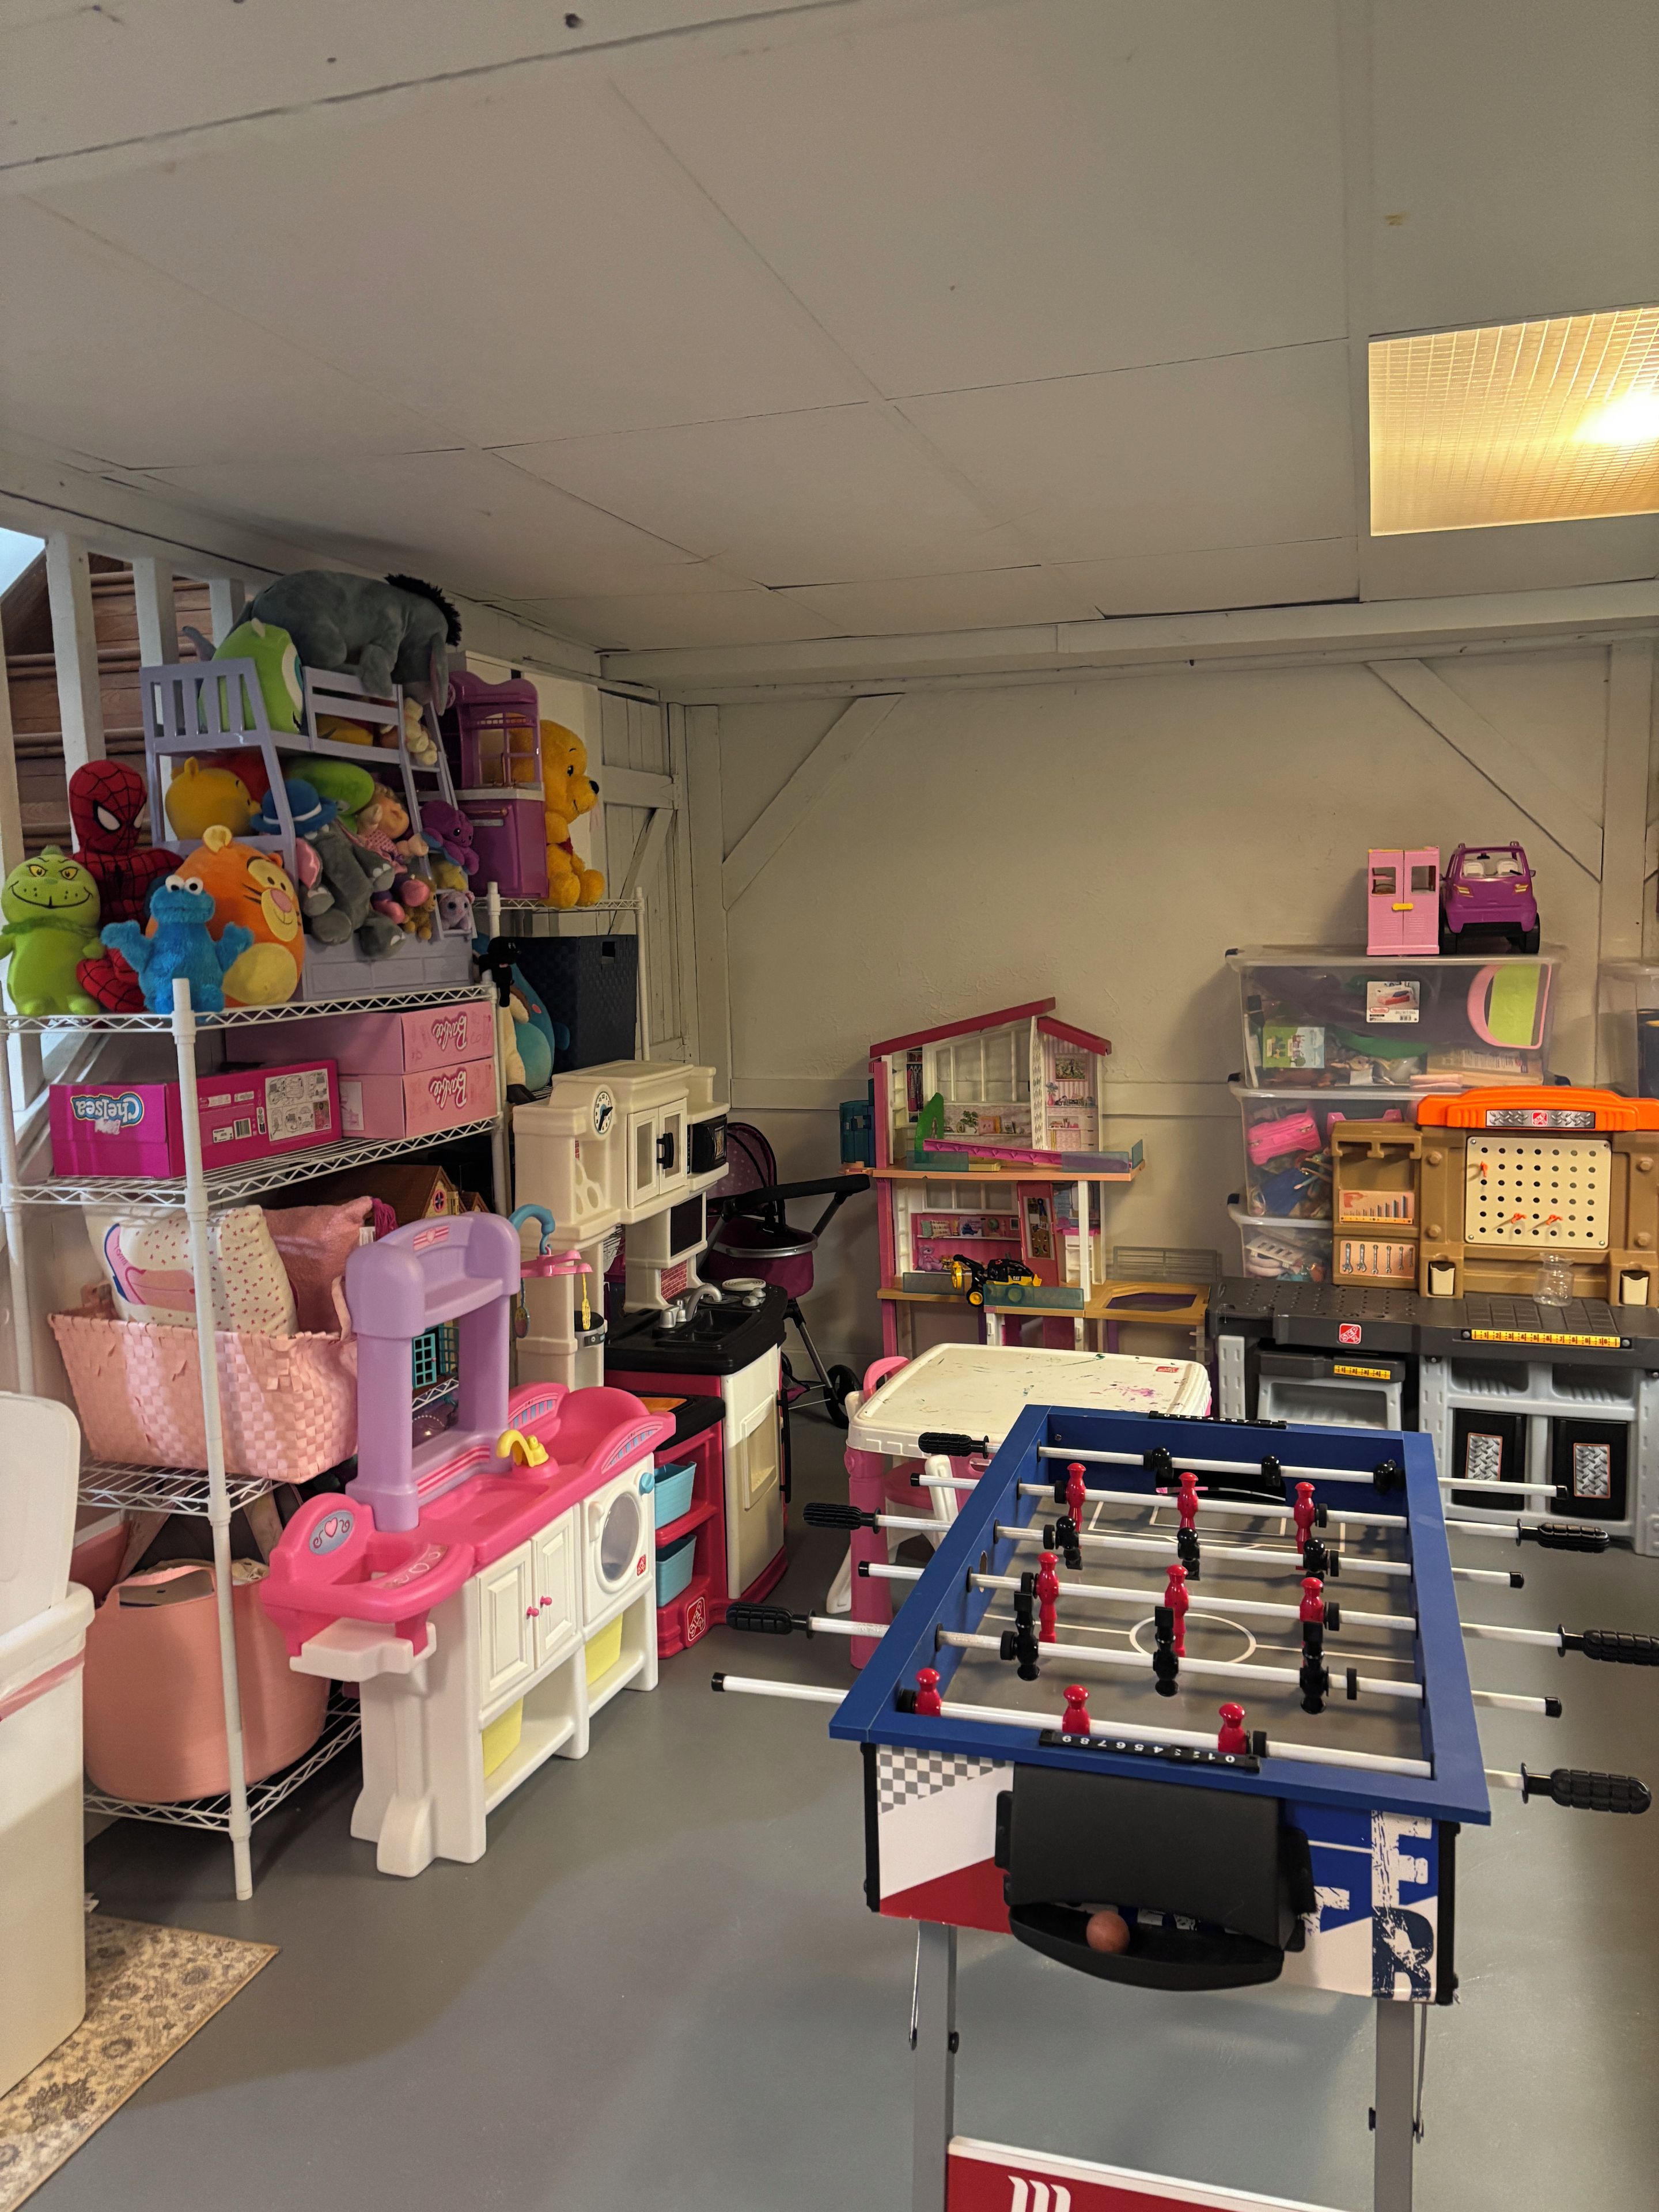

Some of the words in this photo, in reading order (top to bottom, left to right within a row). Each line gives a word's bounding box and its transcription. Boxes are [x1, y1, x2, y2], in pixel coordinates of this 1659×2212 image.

[433, 1015, 467, 1050] Barbie
[430, 1071, 467, 1108] Barbie
[75, 1097, 140, 1123] Chelsea
[1340, 1326, 1358, 1342] STEP
[689, 1601, 702, 1637] STEP
[697, 1617, 704, 1630] 2
[1062, 1735, 1071, 1743] 9
[1080, 1737, 1090, 1745] 8
[1116, 1741, 1126, 1749] 6
[1134, 1744, 1145, 1752] 5
